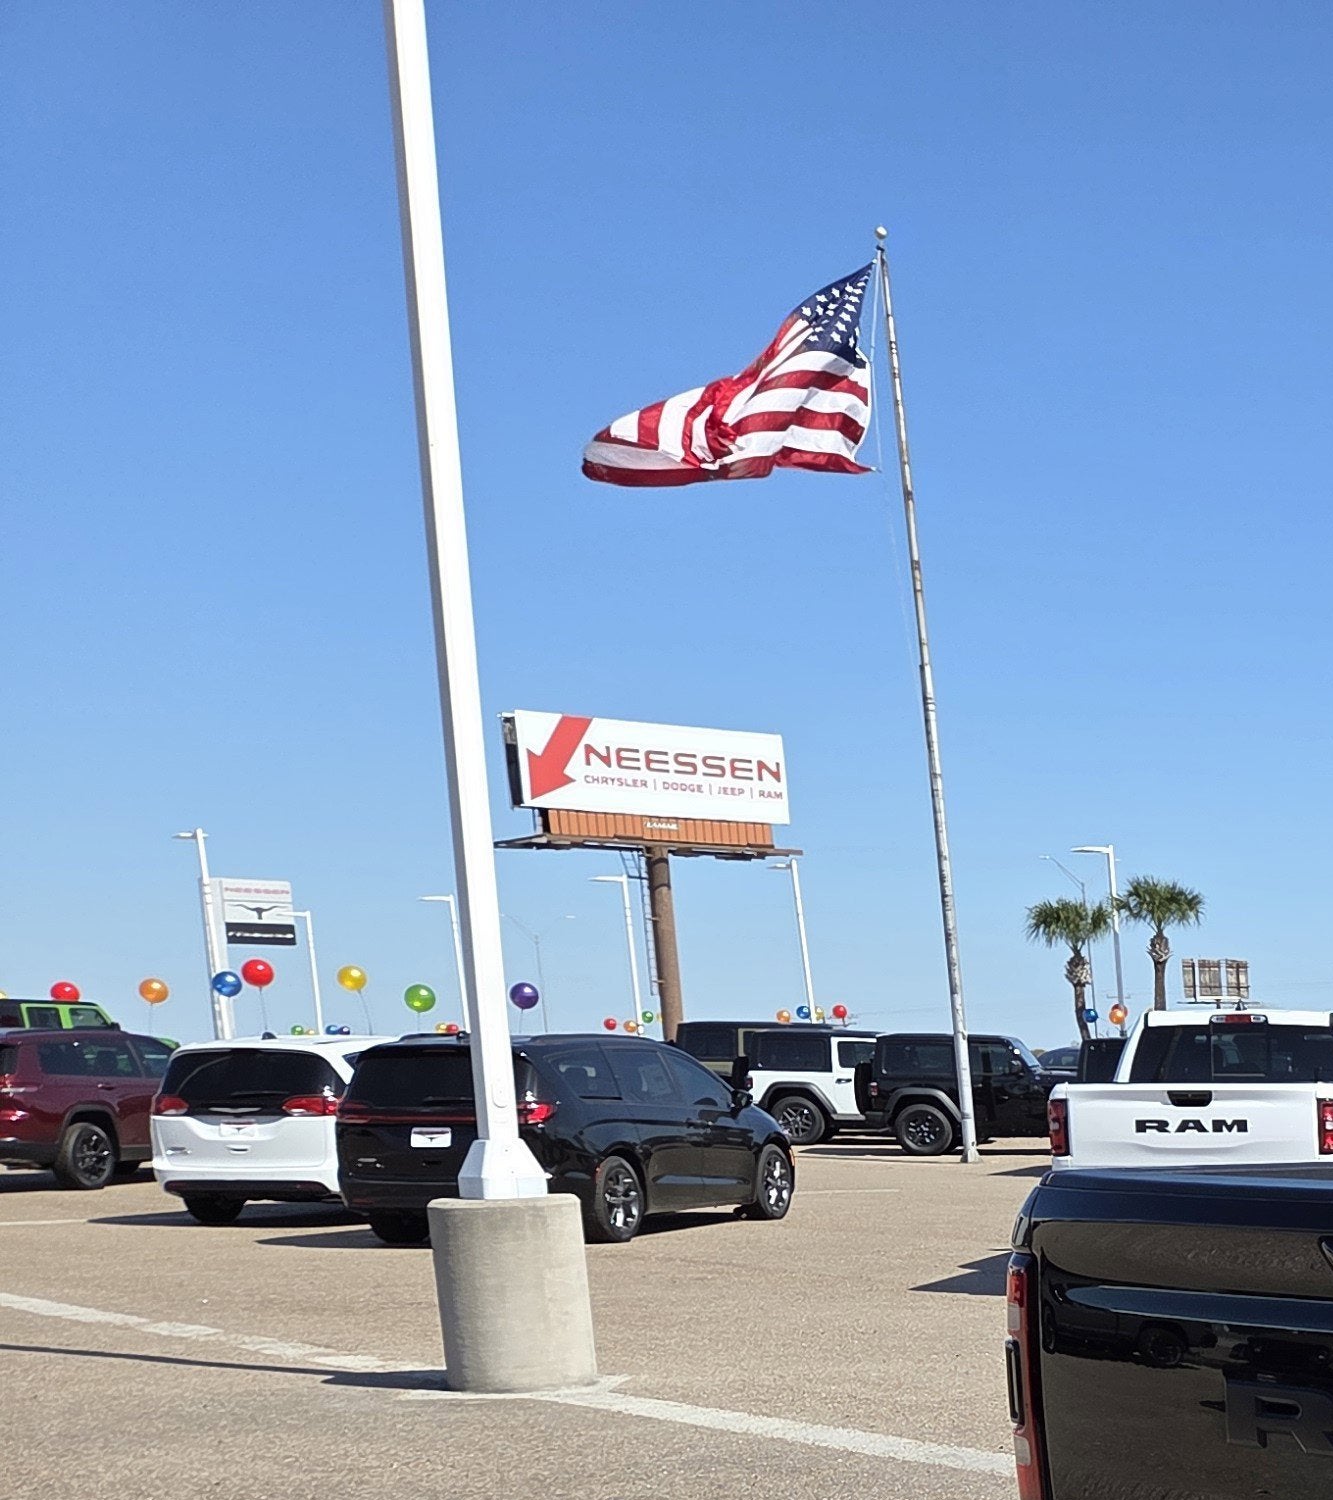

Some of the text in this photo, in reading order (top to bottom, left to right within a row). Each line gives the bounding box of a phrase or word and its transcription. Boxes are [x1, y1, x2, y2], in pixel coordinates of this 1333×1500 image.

[584, 743, 781, 783] NEESSEN
[584, 775, 783, 800] CHRYSLER DODGE JEEP RAM
[1135, 1119, 1248, 1133] RAM
